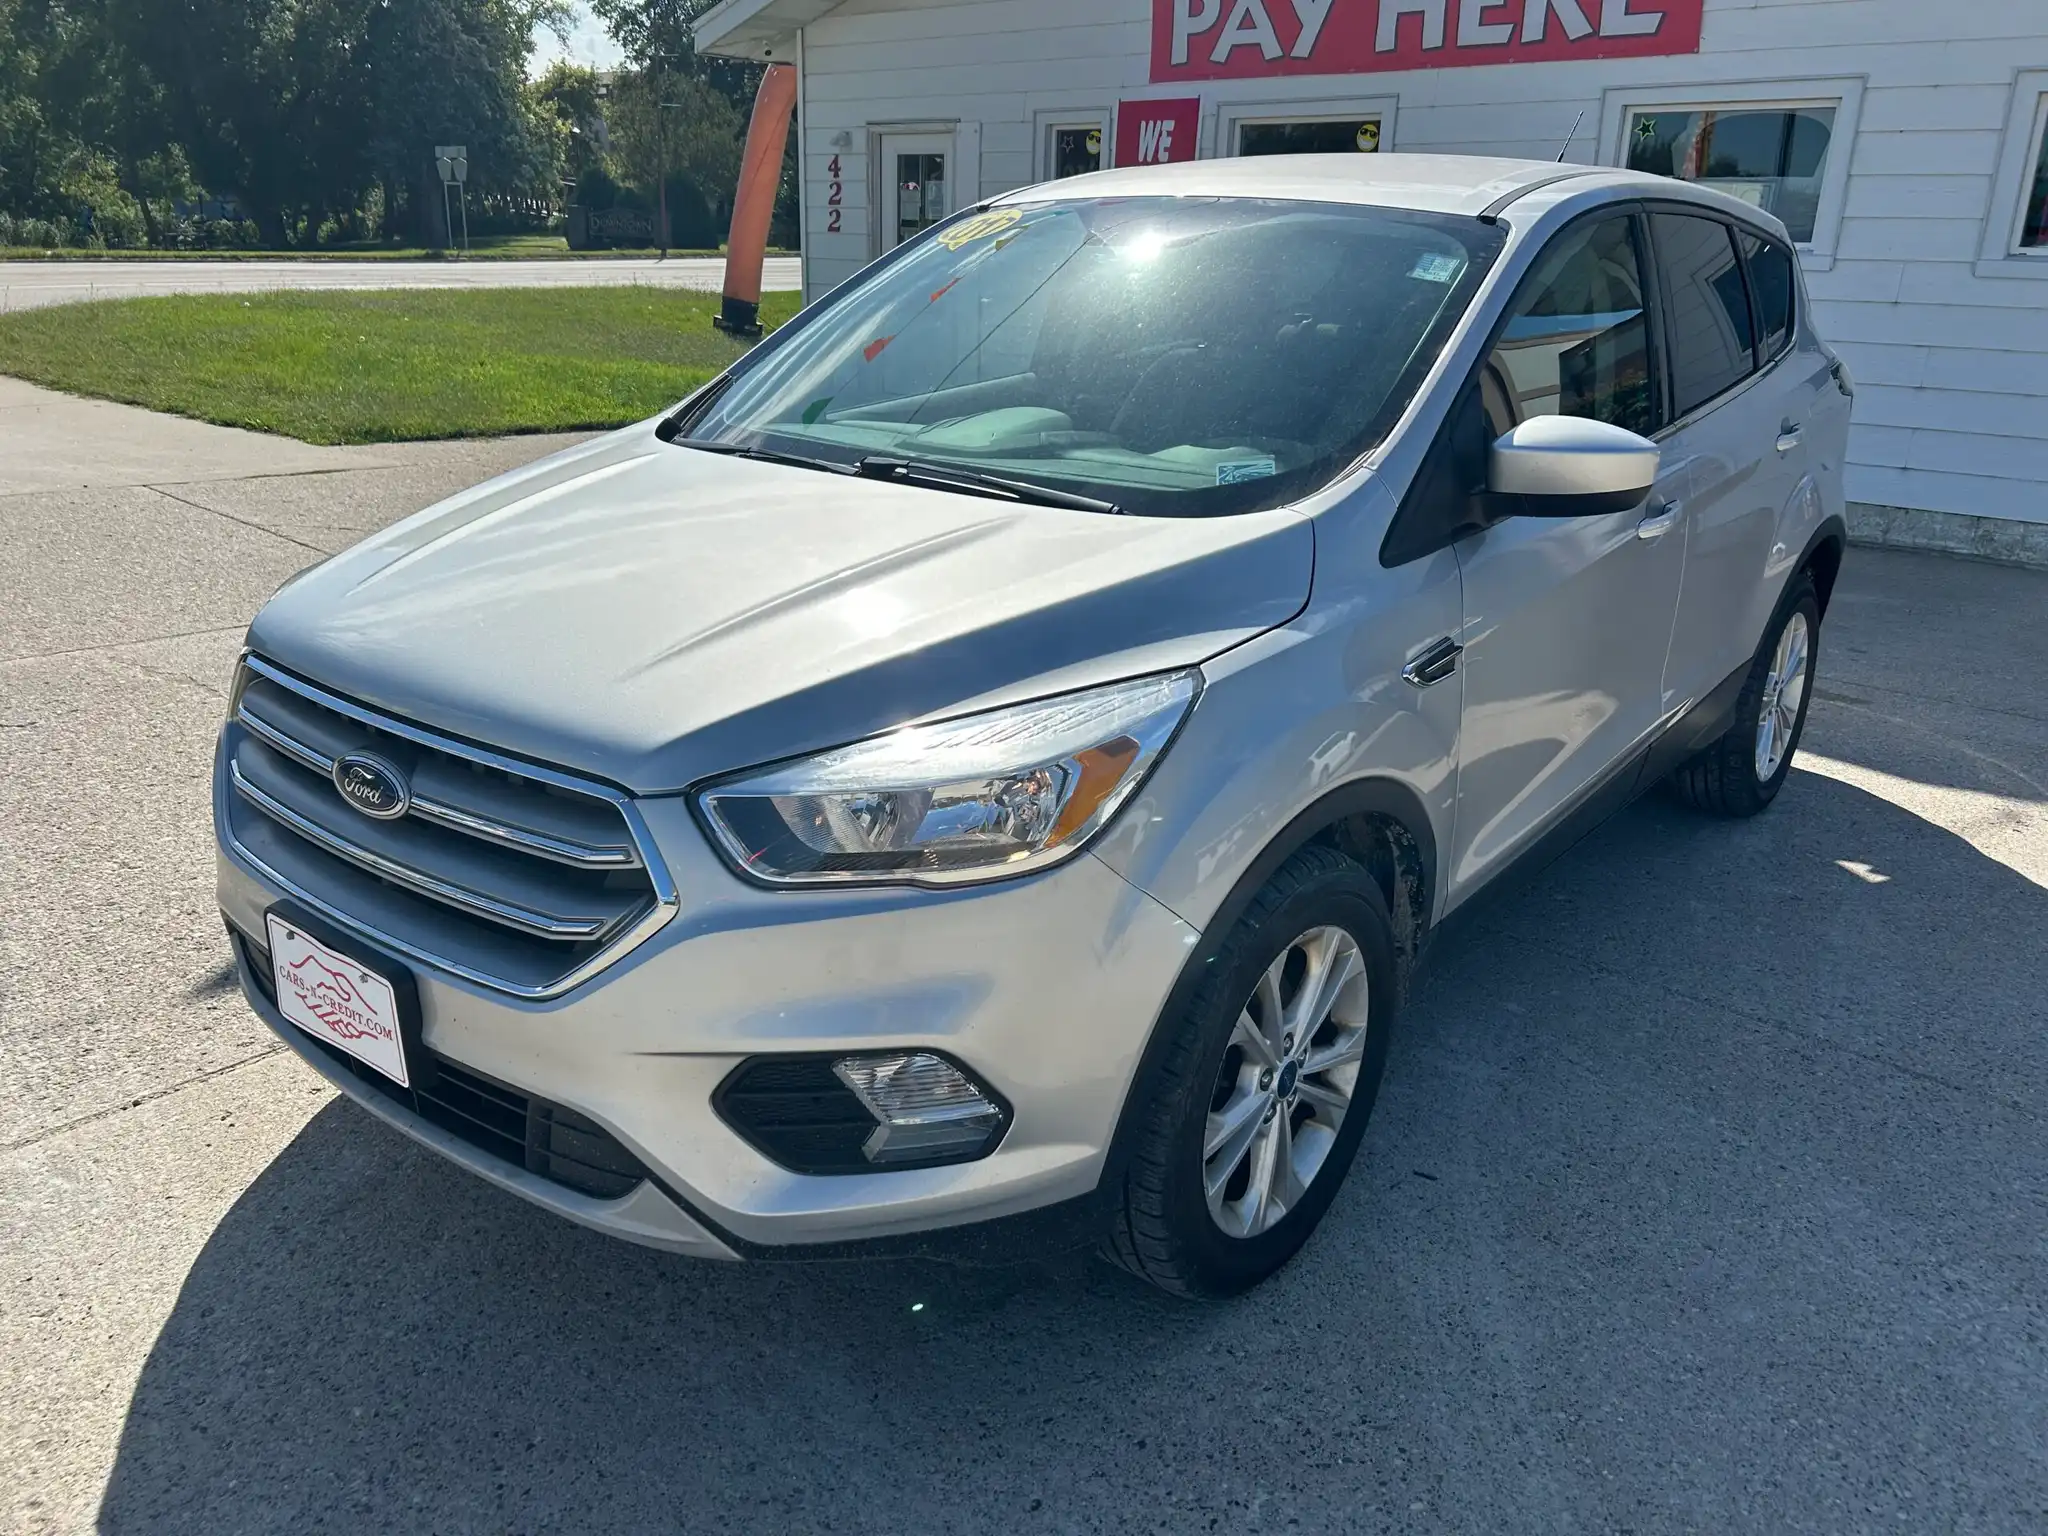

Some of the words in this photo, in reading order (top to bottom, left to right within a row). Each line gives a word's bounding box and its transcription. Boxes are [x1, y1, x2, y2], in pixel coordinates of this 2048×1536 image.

[1171, 0, 1333, 66] PAY
[1138, 120, 1175, 162] WE
[827, 153, 842, 233] 422
[344, 767, 384, 804] Ford
[279, 965, 394, 1041] CARS-N-CREDIT.COM
